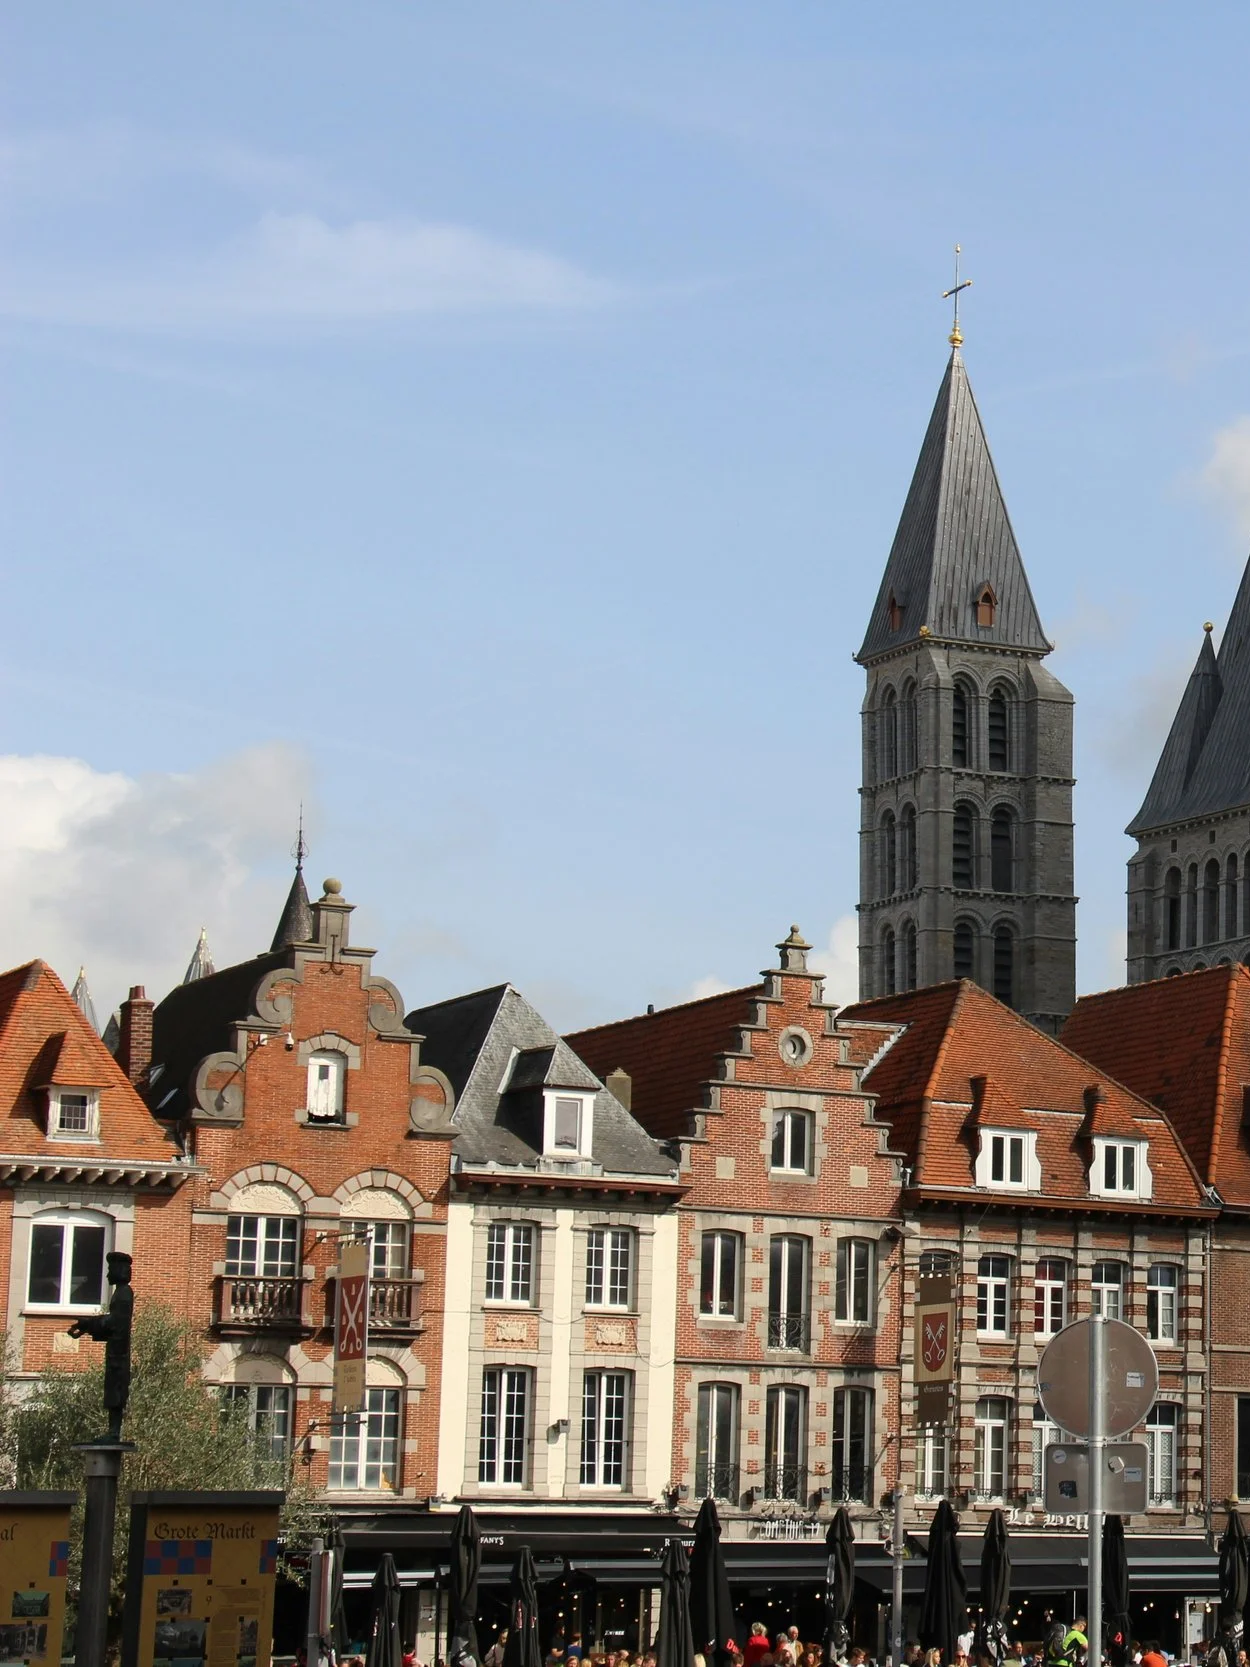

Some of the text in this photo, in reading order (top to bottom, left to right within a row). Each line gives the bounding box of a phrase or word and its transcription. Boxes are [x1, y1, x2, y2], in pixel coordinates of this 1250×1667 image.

[1004, 1507, 1035, 1526] Le
[154, 1521, 198, 1540] Grote
[206, 1522, 256, 1540] Markt
